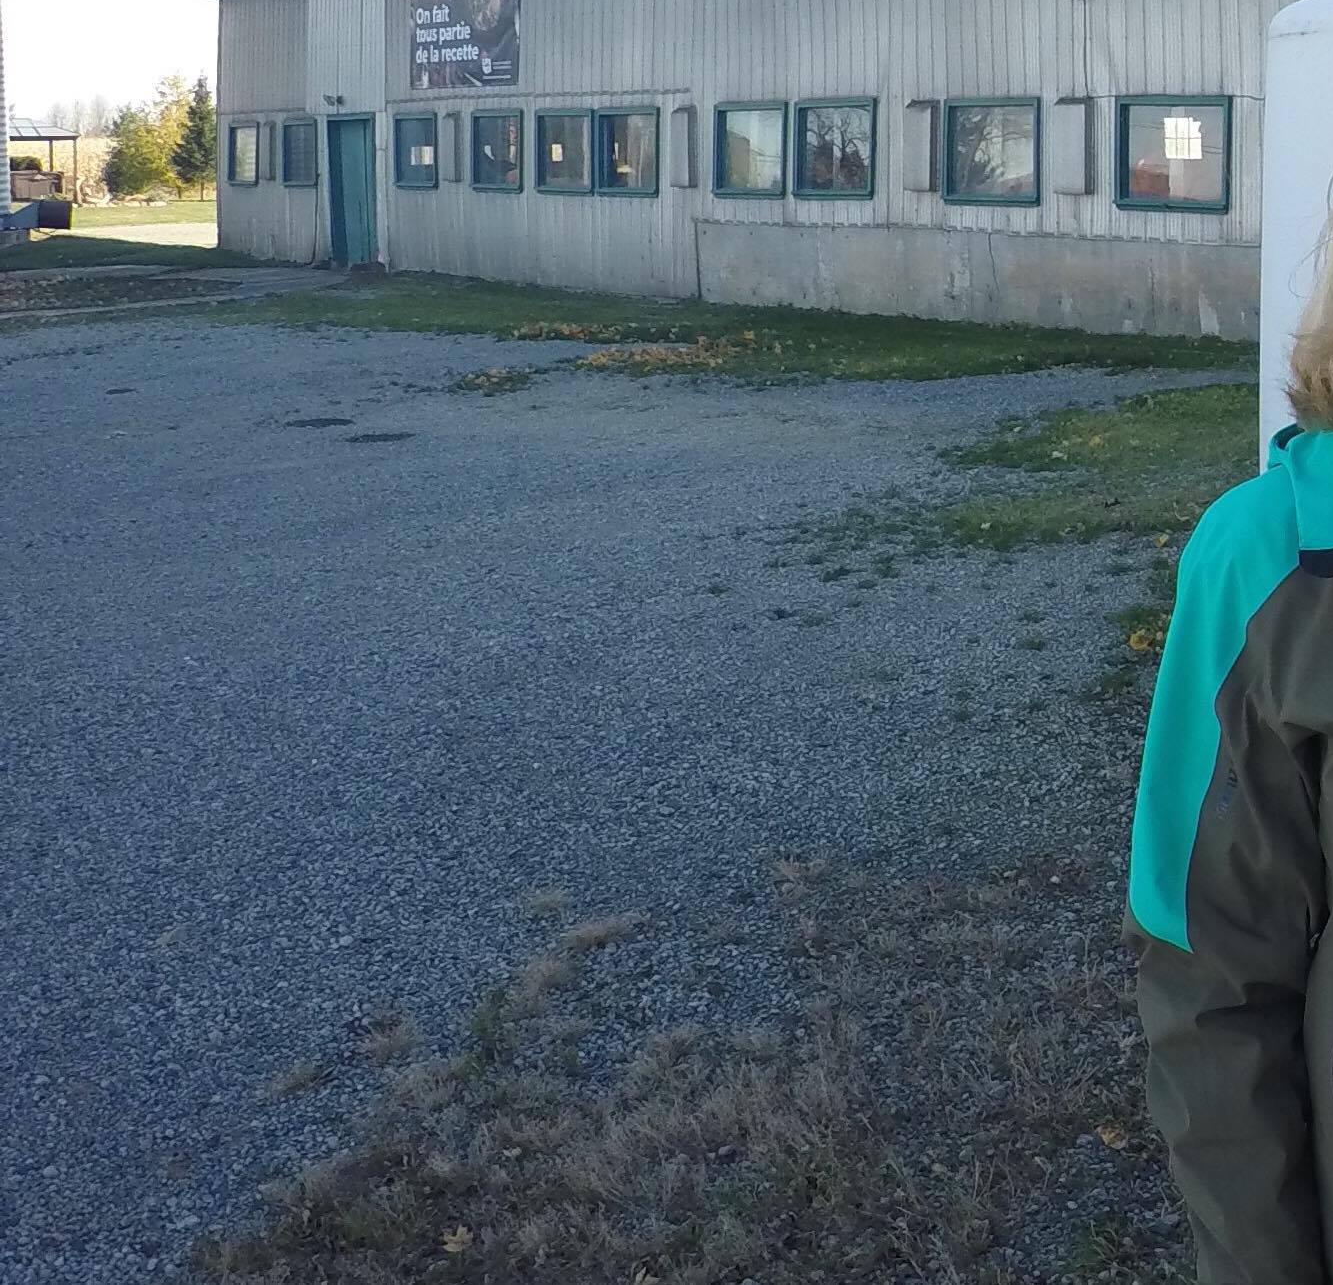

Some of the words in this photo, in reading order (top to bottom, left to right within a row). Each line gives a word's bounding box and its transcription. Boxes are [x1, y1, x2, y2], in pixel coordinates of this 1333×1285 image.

[416, 8, 430, 24] On
[433, 4, 449, 22] fait
[416, 27, 437, 43] tous
[439, 21, 471, 45] partie
[416, 46, 428, 63] de
[430, 44, 440, 63] la
[442, 44, 479, 62] recette
